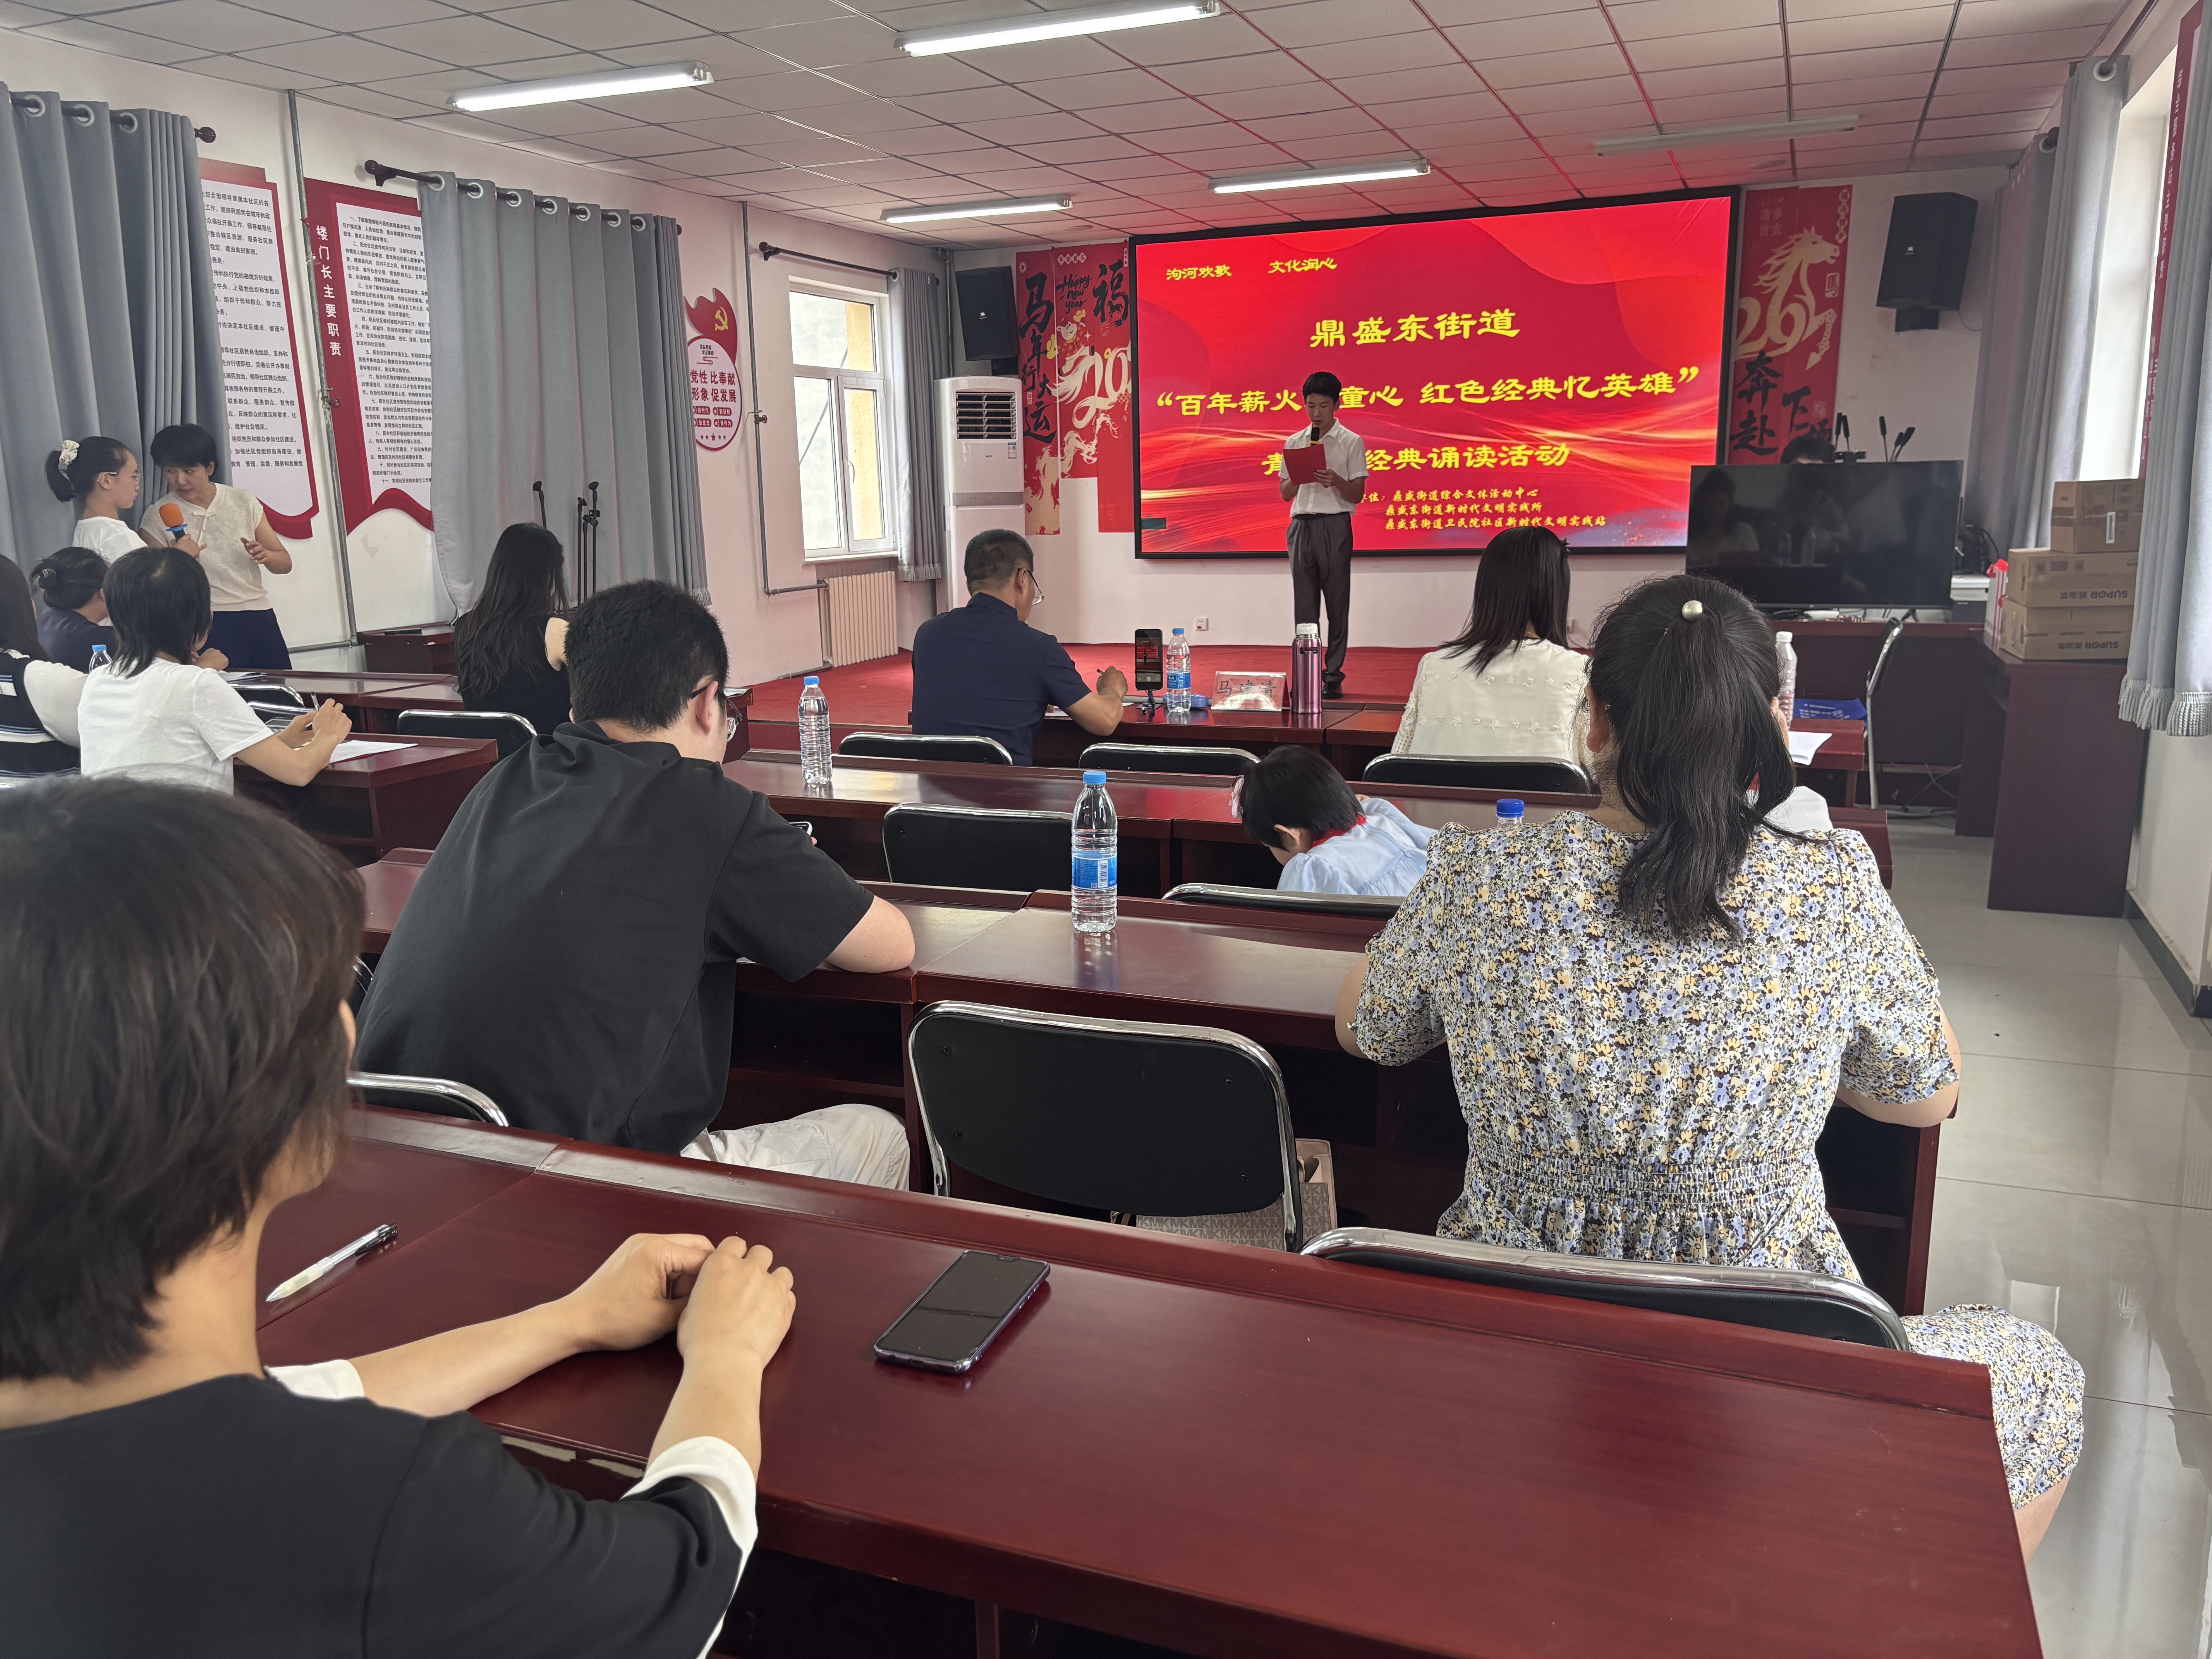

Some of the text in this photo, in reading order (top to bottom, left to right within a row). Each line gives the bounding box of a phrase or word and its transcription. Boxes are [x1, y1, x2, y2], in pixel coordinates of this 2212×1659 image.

[1268, 257, 1337, 274] 文化润心
[316, 225, 341, 356] 楼门长主要职责
[1056, 274, 1092, 292] Happy
[1093, 259, 1129, 327] 福
[1065, 299, 1087, 314] year
[1310, 308, 1520, 348] 鼎盛东街道
[690, 369, 736, 385] 党性 比奉献
[692, 388, 736, 402] 形象 促发展
[1157, 366, 1699, 416] “百年薪火童心 红色经典忆英雄”
[1729, 350, 1783, 455] 奔赴
[1261, 443, 1570, 476] 青经典诵读活动
[1393, 487, 1539, 502] 鼎盛街道综合文体活动中心
[1385, 502, 1542, 517] 鼎盛东街道新时代文明实践所
[2091, 591, 2128, 599] SUPOR
[1216, 680, 1277, 699] 马建清
